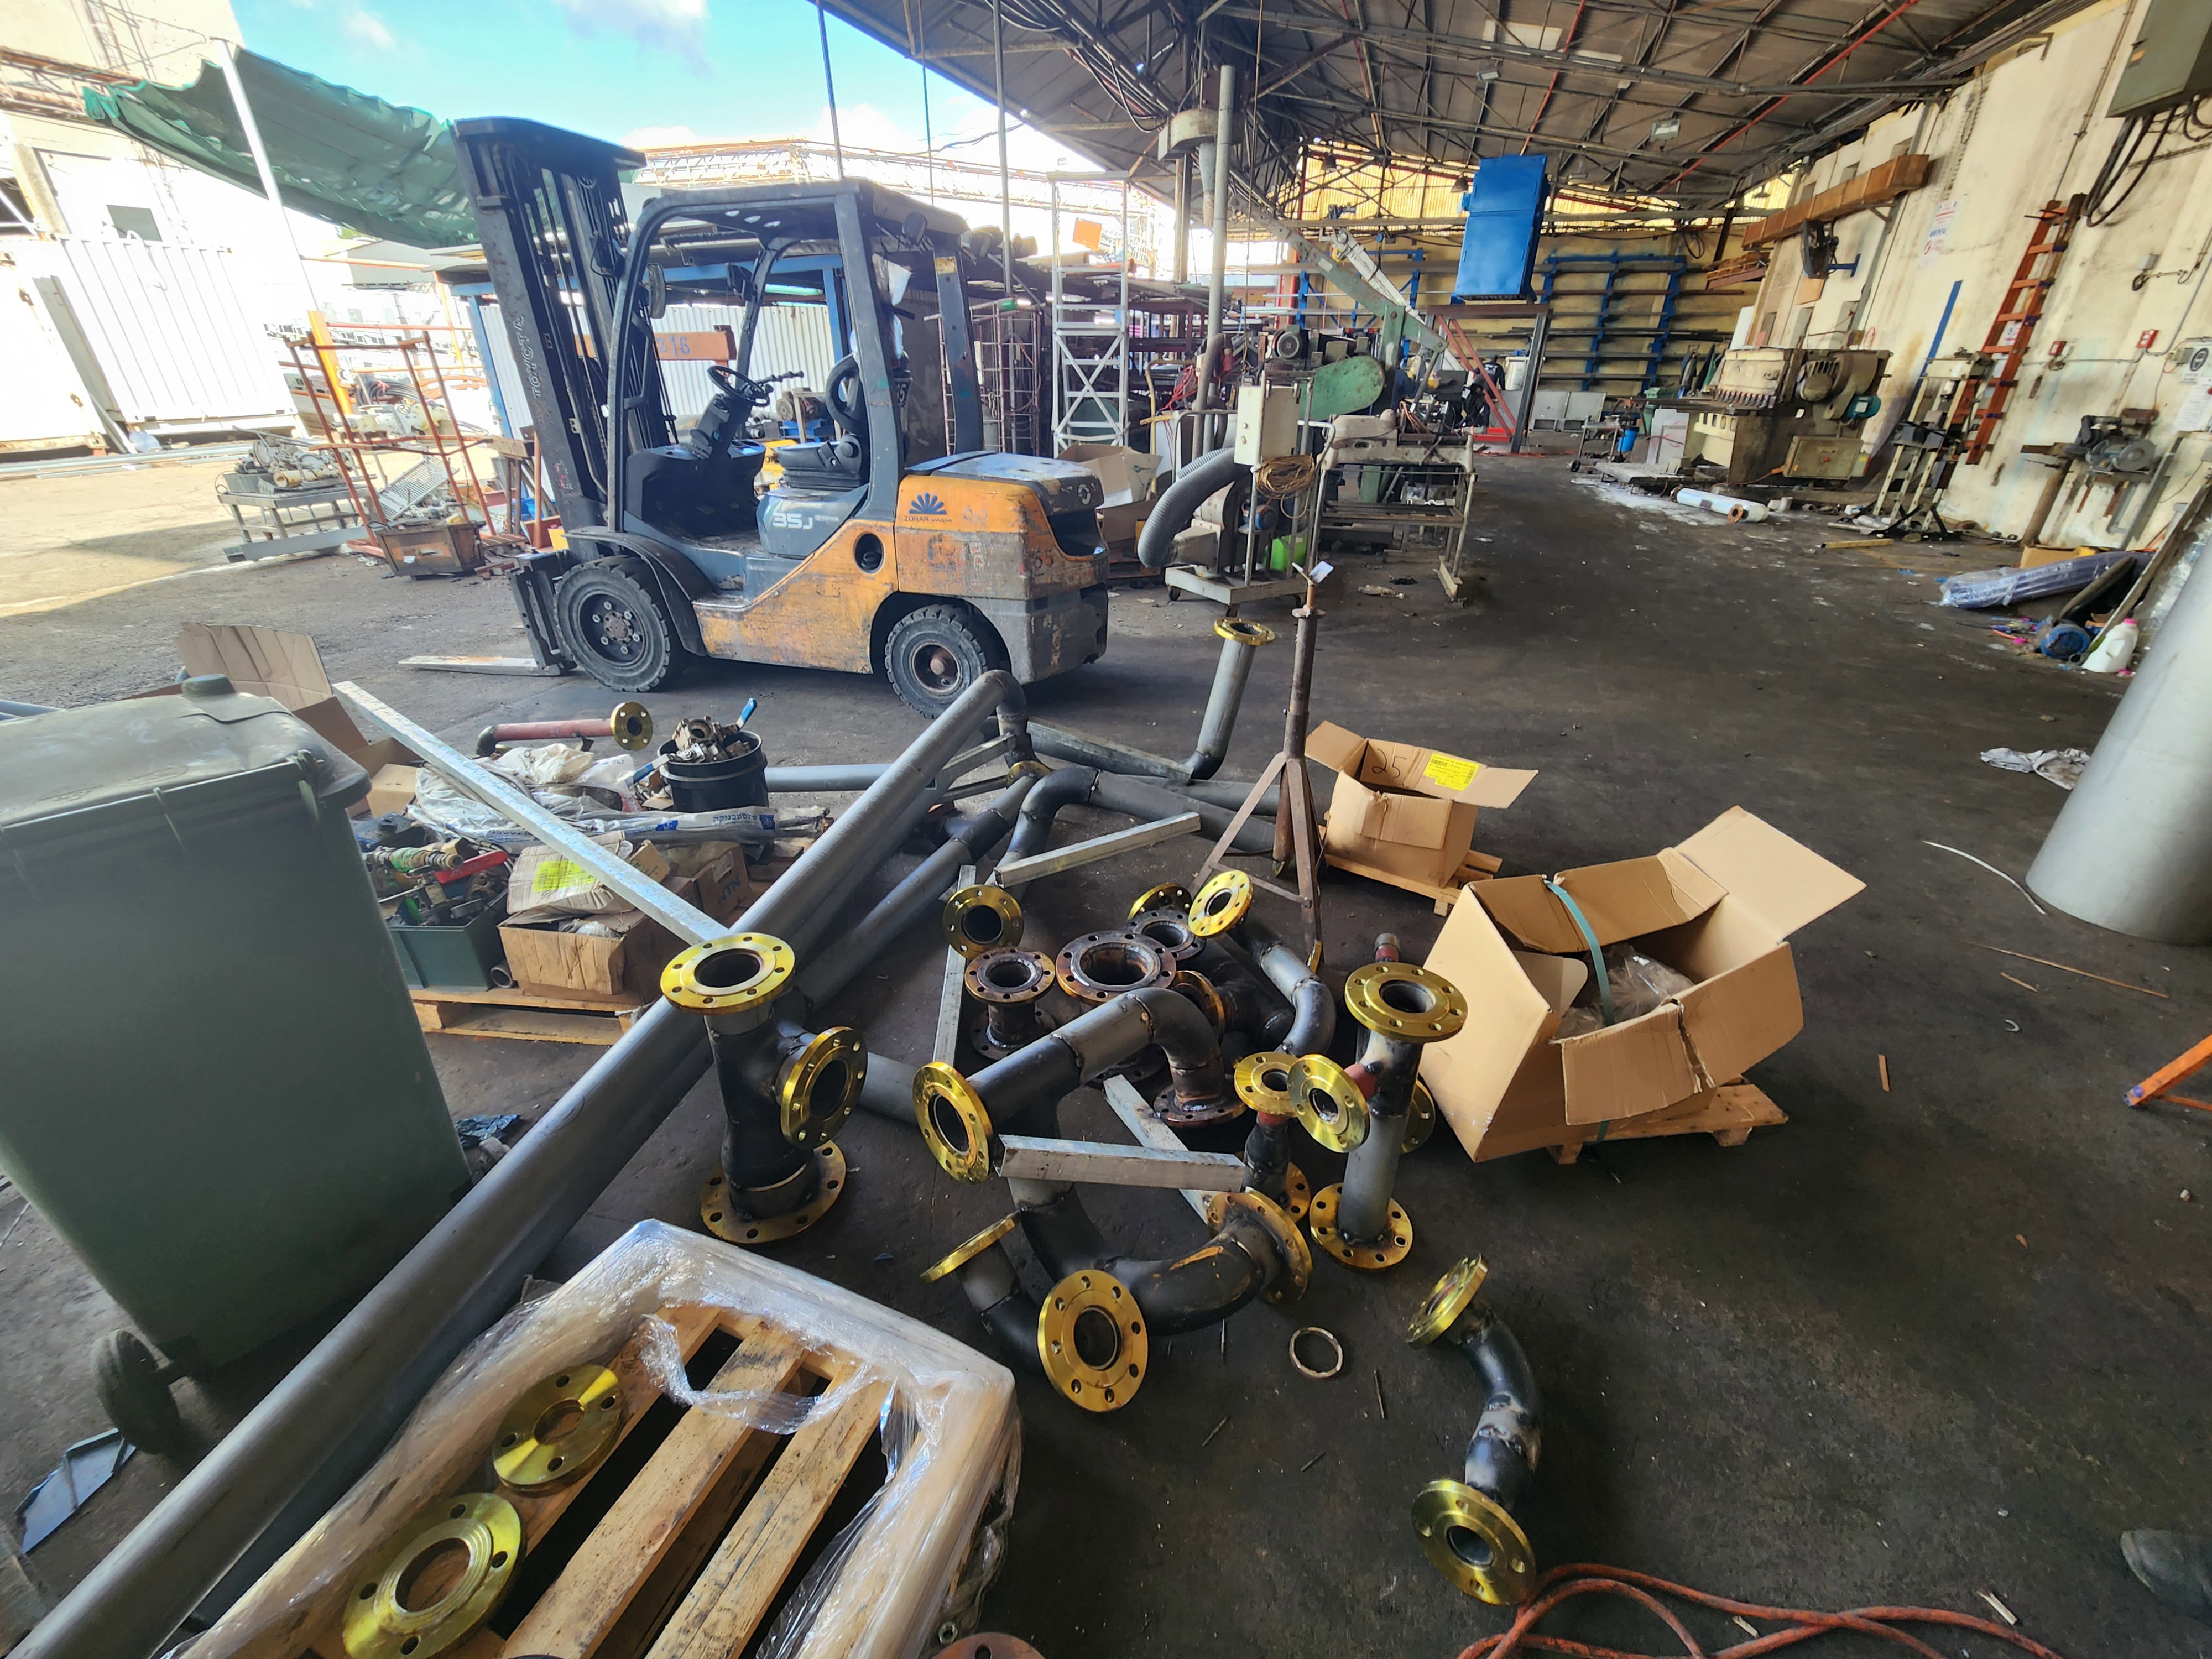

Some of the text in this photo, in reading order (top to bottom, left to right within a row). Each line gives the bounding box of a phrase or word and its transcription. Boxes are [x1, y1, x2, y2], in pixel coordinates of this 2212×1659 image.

[513, 315, 541, 399] TOYOTA
[773, 512, 813, 529] 35J
[1371, 748, 1407, 779] 25
[717, 875, 742, 906] NTN
